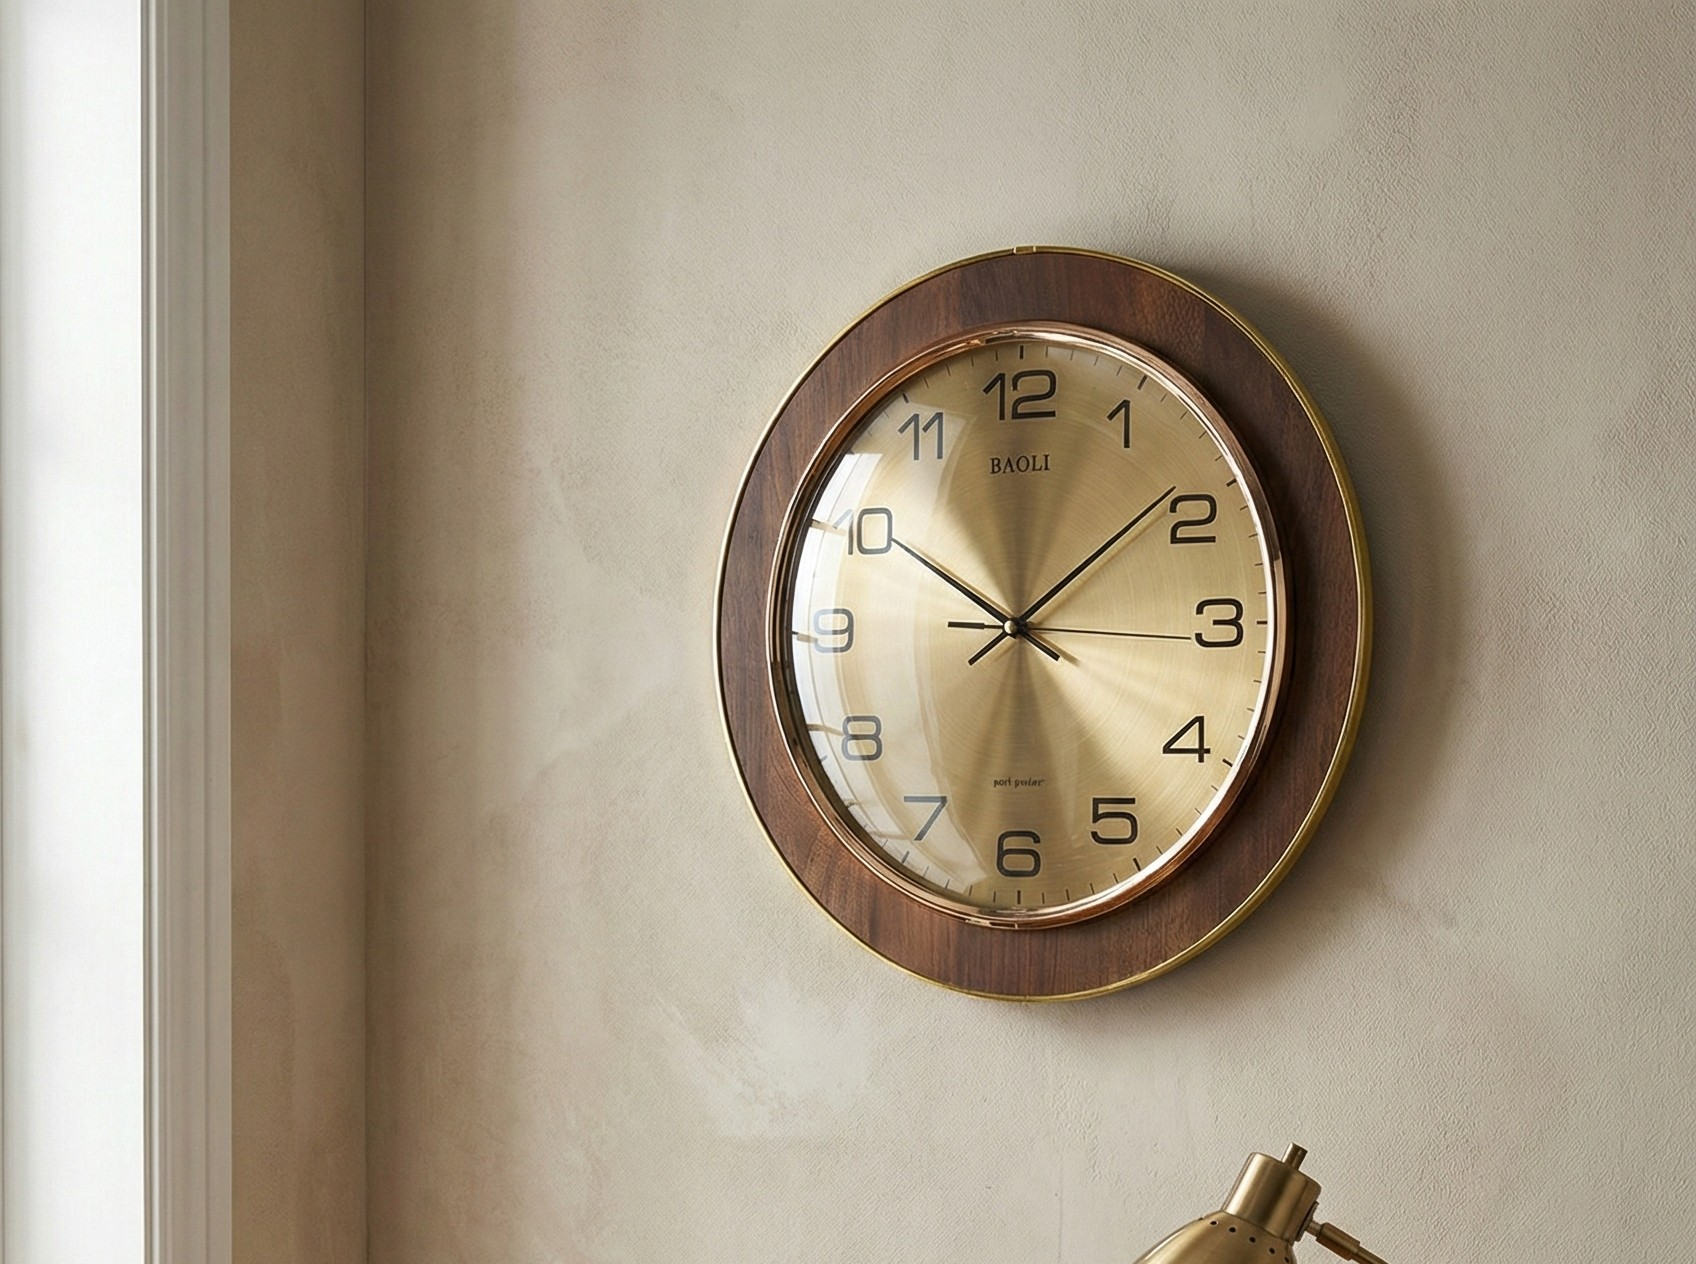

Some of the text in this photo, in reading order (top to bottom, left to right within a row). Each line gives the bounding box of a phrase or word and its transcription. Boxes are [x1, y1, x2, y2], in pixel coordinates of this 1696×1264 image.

[982, 369, 1057, 421] 12
[897, 411, 945, 461] 11
[1106, 400, 1131, 449] 1
[989, 453, 1051, 475] BAOLI
[832, 507, 893, 555] 10
[1168, 493, 1217, 544] 2
[813, 608, 854, 653] 9
[1194, 598, 1244, 648] 3
[840, 715, 883, 761] 8
[1162, 715, 1211, 763] 4
[903, 795, 947, 841] 7
[1090, 797, 1139, 845] 5
[995, 830, 1041, 877] 6
